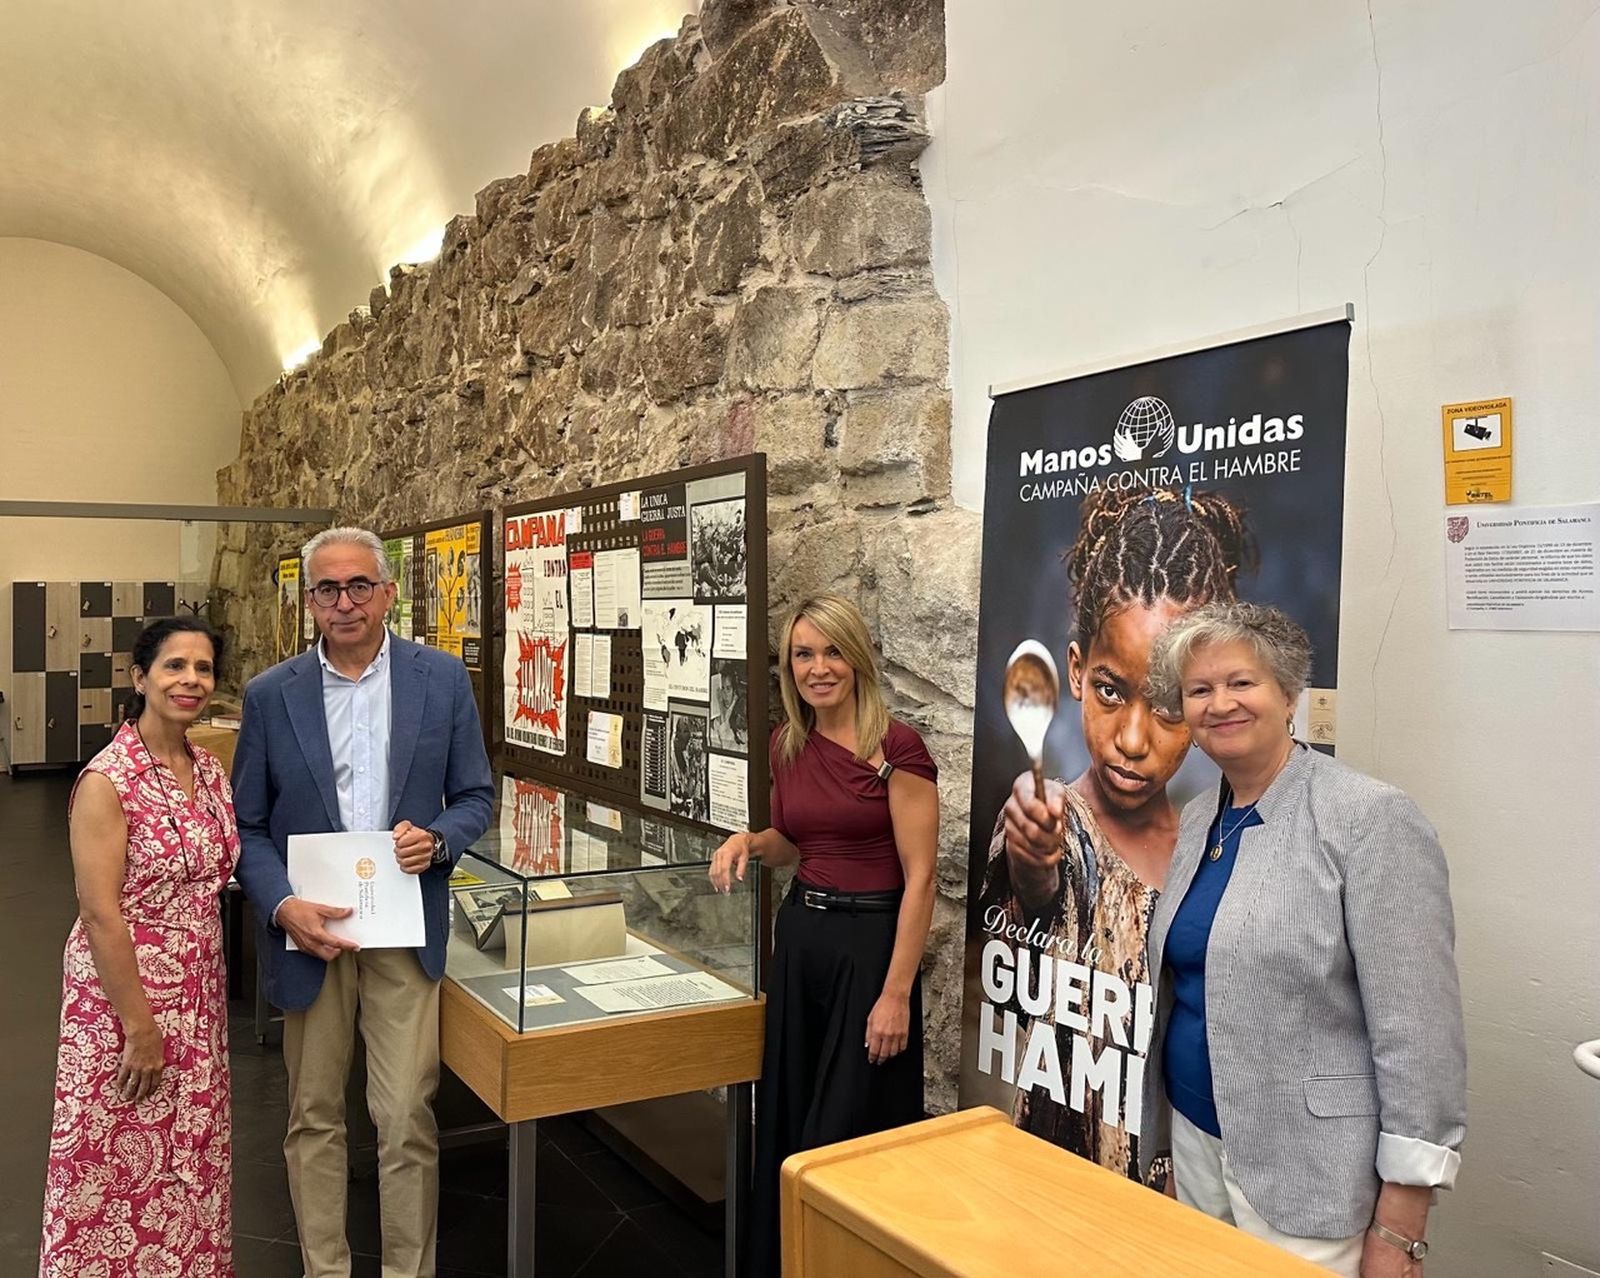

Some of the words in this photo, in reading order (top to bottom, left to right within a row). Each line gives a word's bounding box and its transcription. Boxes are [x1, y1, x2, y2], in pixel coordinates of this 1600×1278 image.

[1020, 444, 1112, 477] Manos
[1178, 414, 1304, 454] Unidas
[1020, 472, 1100, 502] CAMPAÑA
[1107, 464, 1183, 494] CONTRA
[1190, 460, 1207, 482] EL
[1214, 450, 1301, 480] HAMBRE
[641, 495, 649, 509] LA
[666, 505, 686, 520] JUSTA
[555, 590, 563, 609] EL
[983, 904, 1076, 957] Declara
[1081, 939, 1103, 965] la
